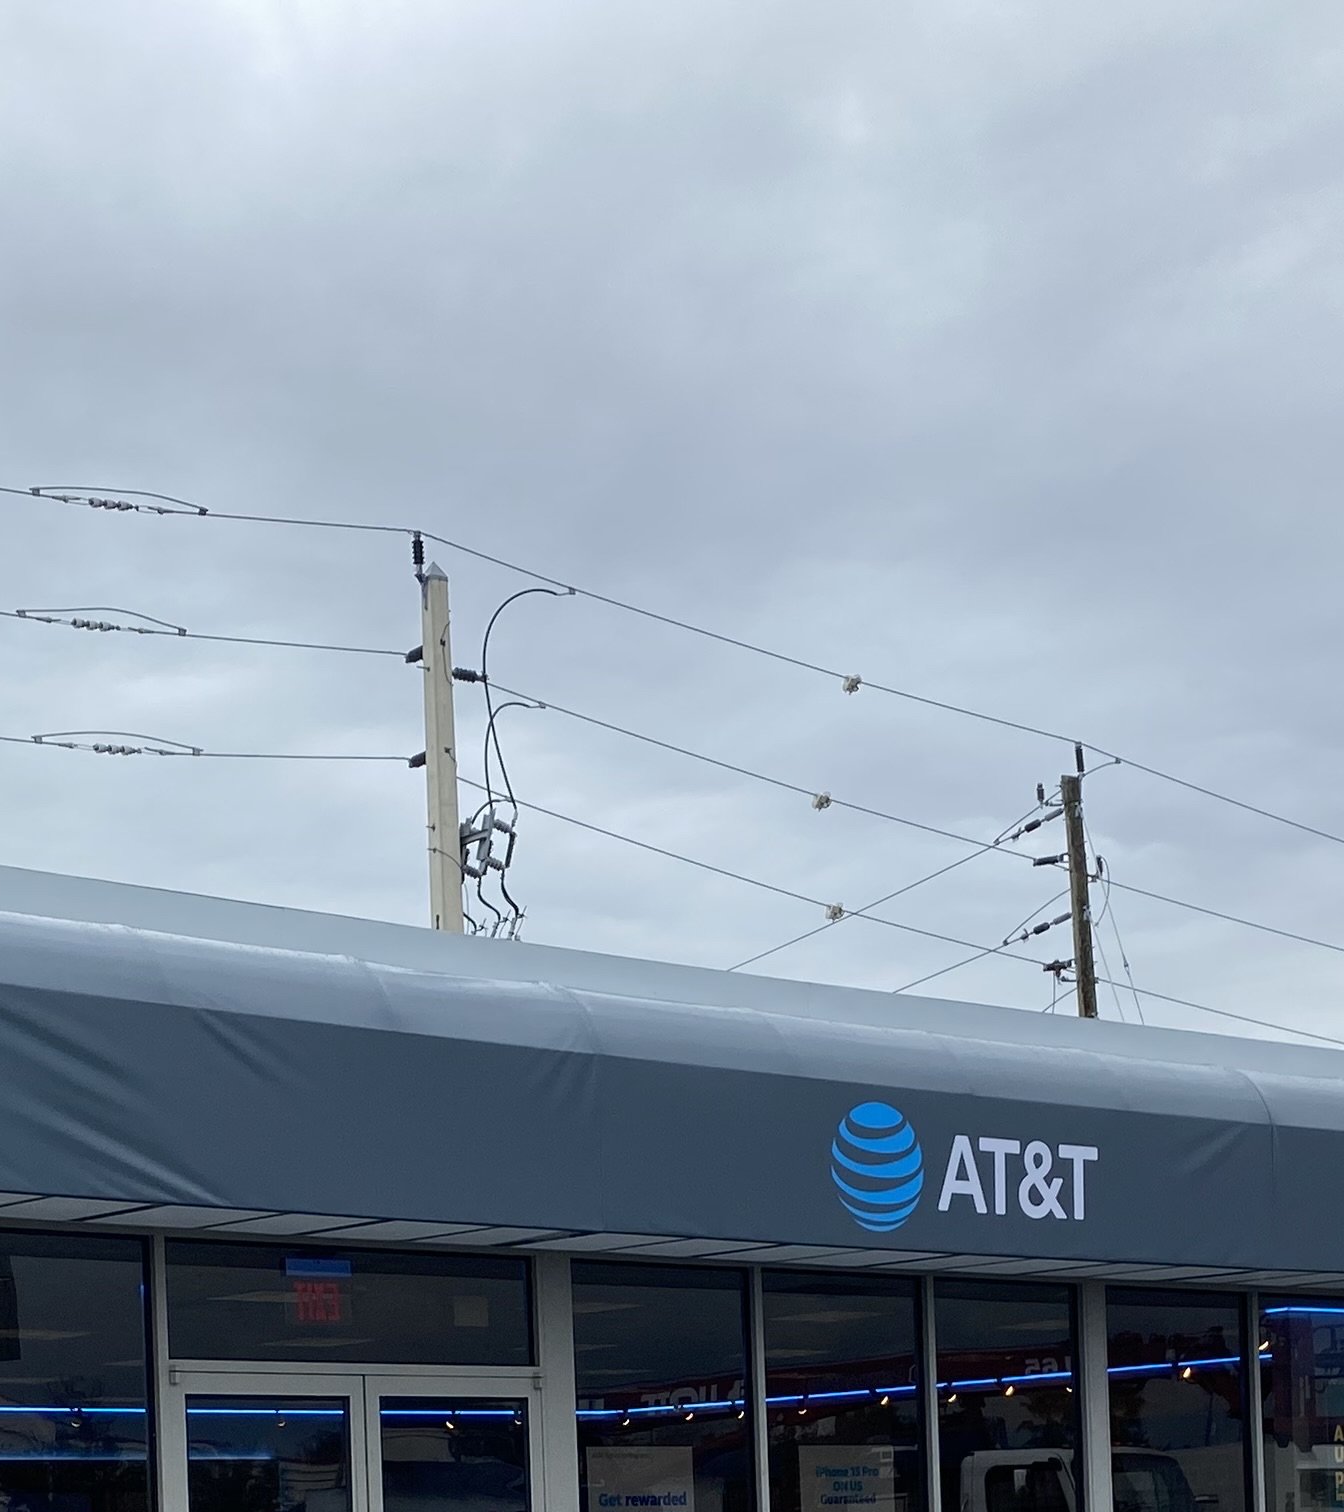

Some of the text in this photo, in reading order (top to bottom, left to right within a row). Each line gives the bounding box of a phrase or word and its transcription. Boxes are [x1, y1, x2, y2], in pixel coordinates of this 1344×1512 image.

[937, 1134, 1099, 1220] AT&T
[599, 1491, 687, 1507] Get rewarded
